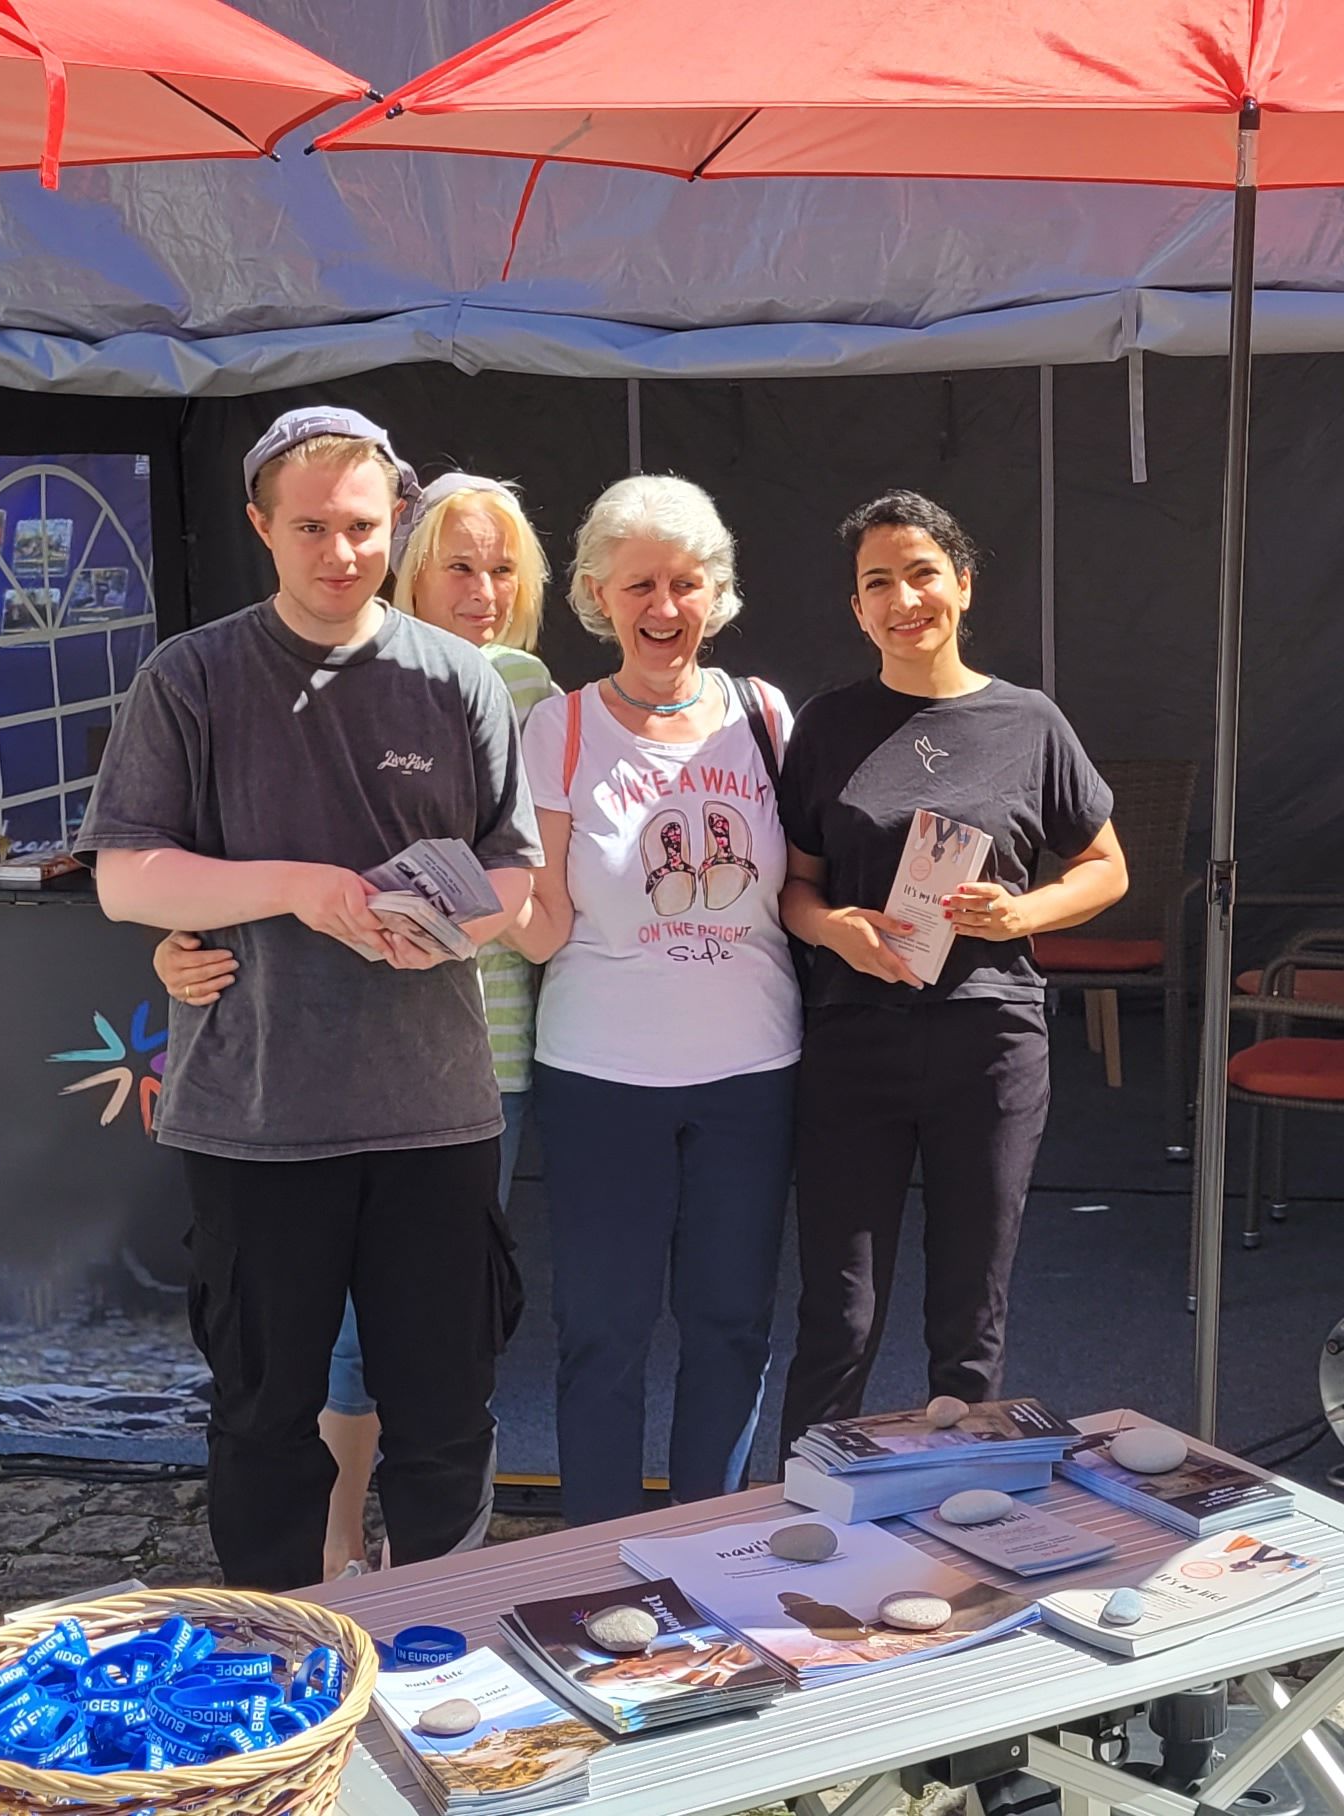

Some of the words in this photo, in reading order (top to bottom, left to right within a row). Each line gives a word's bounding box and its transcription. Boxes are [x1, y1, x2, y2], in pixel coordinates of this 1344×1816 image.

[602, 770, 673, 817] TAKE
[678, 766, 697, 794] A
[701, 765, 769, 806] WALK
[638, 926, 661, 944] ON
[662, 922, 694, 938] THE
[698, 925, 752, 944] BRIGHT
[397, 1648, 406, 1660] IN
[408, 1650, 454, 1664] EUROPE
